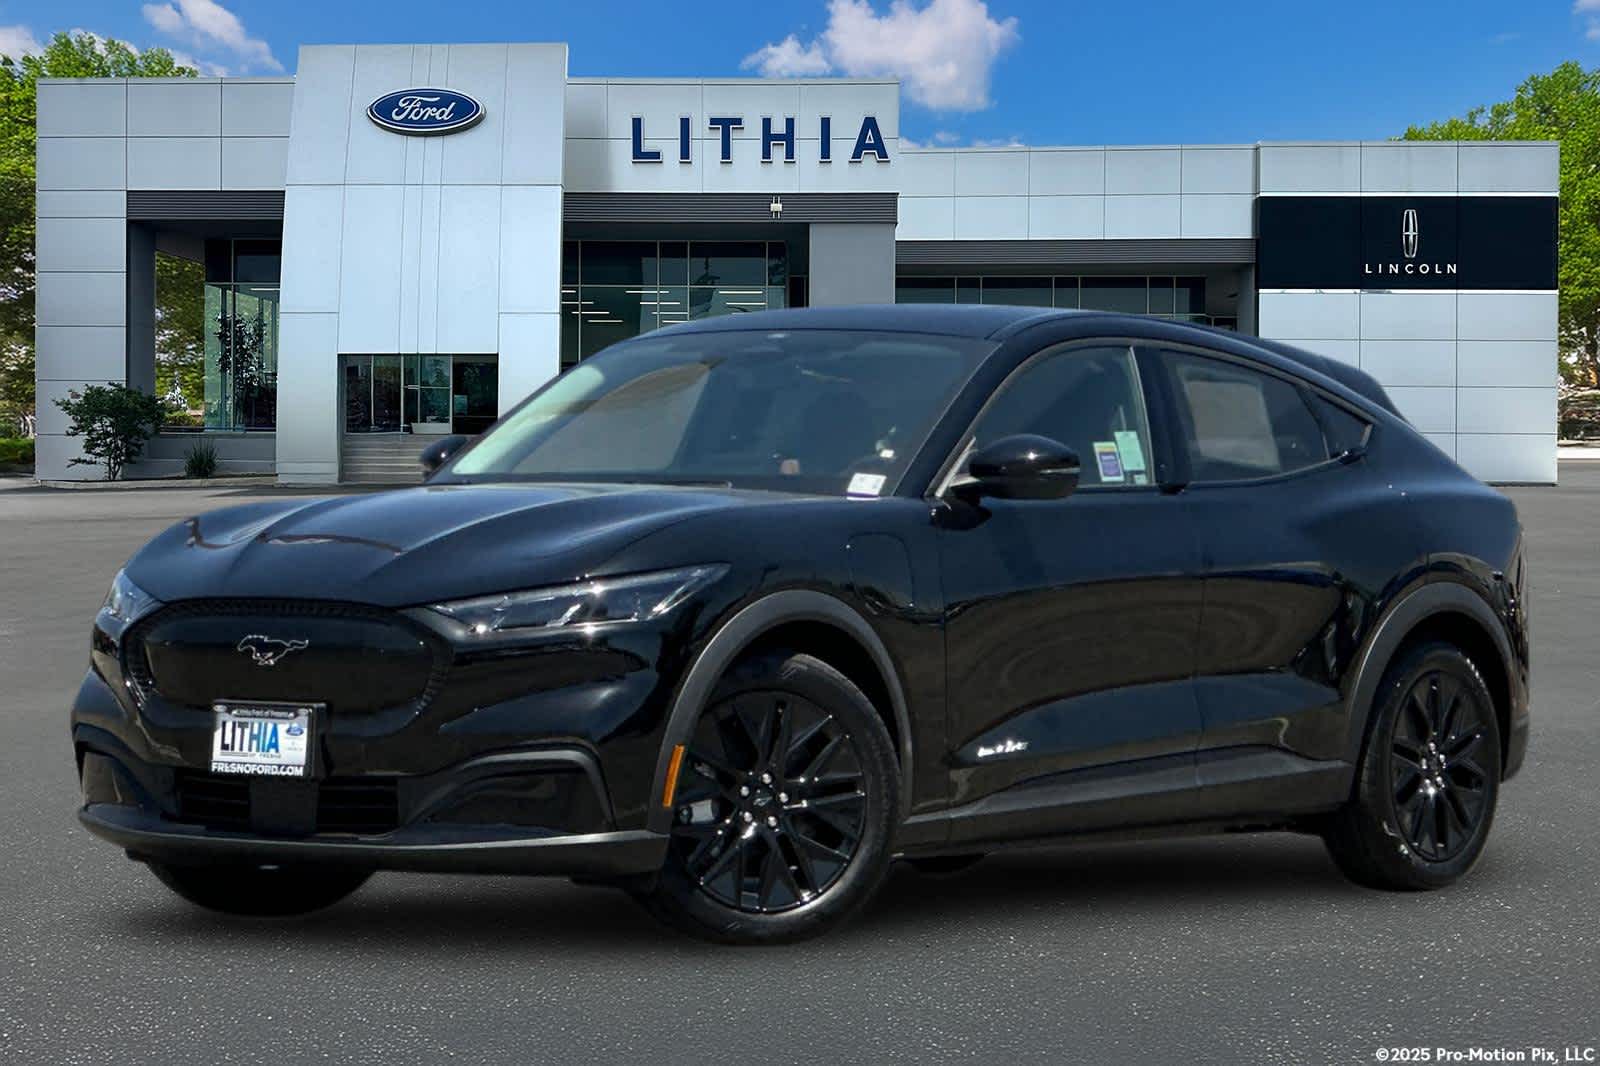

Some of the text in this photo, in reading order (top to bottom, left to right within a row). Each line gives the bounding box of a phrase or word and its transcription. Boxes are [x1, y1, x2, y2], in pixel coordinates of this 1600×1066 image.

[391, 95, 456, 120] Ford
[630, 115, 890, 163] LITHIA
[1365, 263, 1457, 274] LINCOLN
[220, 720, 280, 753] LITHIA
[211, 762, 304, 777] FRESNOFORD.COM
